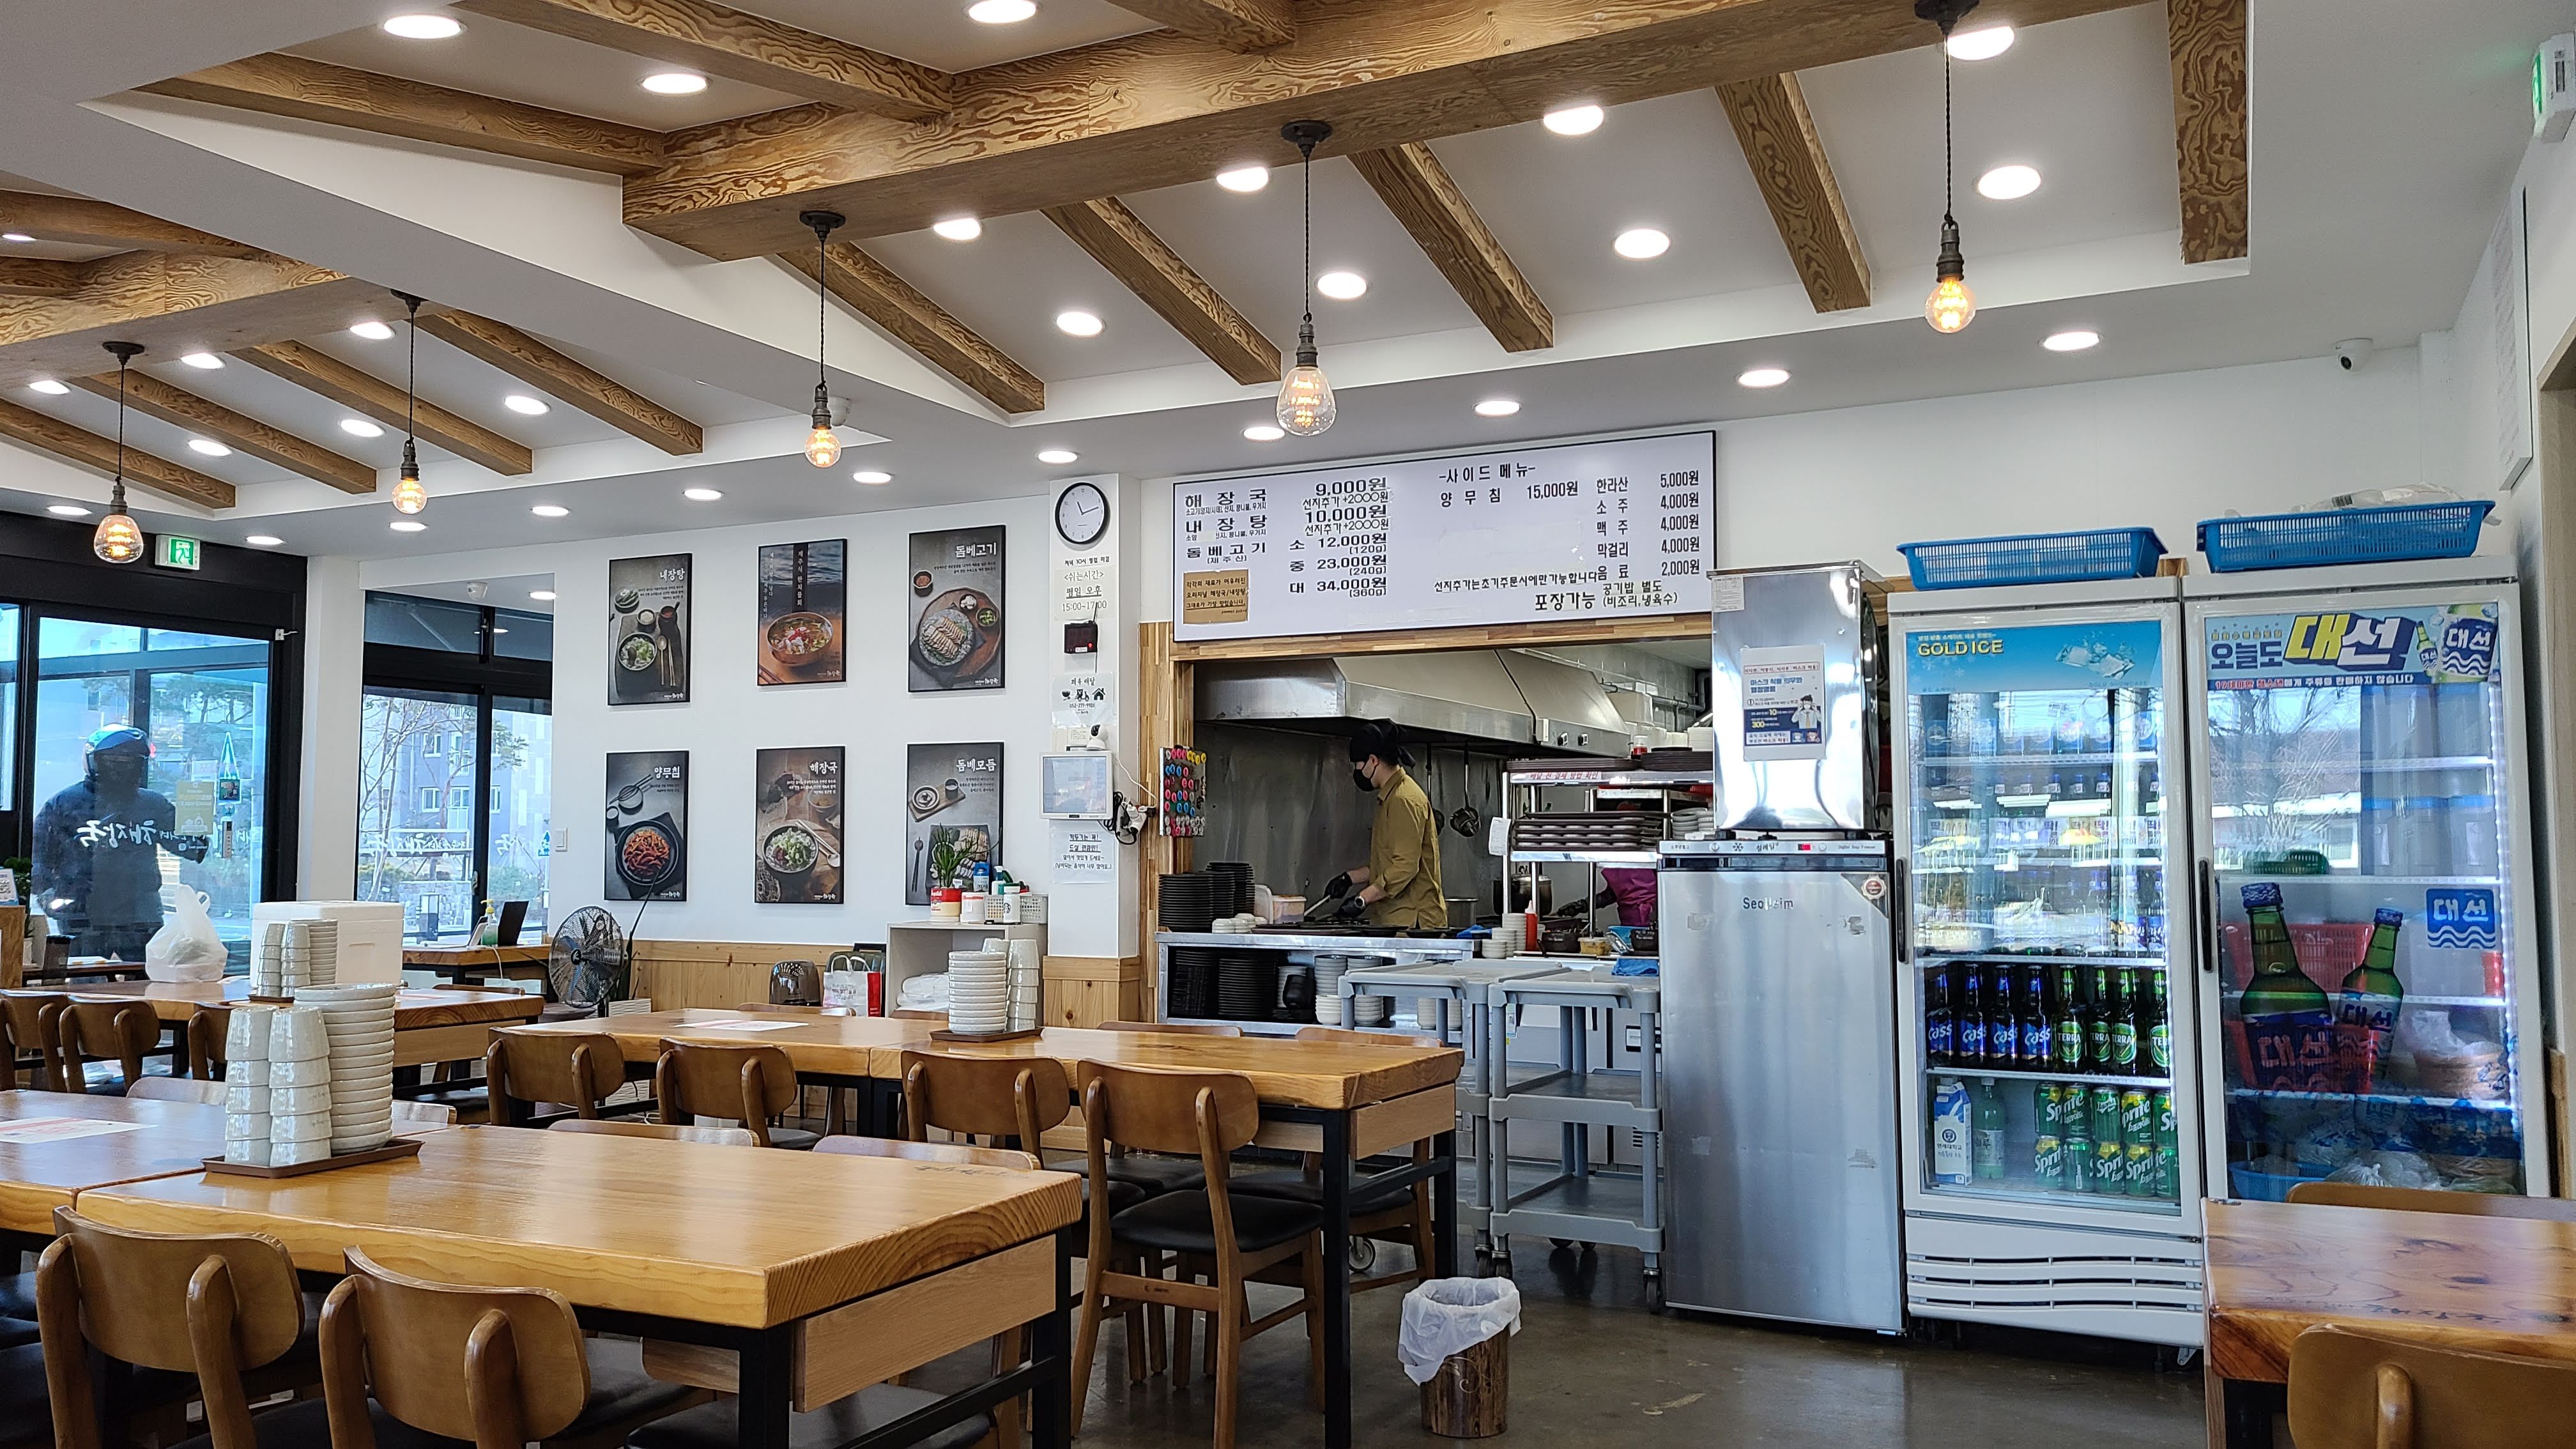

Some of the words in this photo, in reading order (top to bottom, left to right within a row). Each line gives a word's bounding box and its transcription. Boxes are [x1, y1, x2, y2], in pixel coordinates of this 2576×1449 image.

[1315, 477, 1386, 496] 9,000원
[1526, 480, 1578, 500] 15,000원
[1597, 477, 1629, 494] 한라산
[1660, 470, 1699, 487] 5,000원
[1302, 496, 1340, 510] 선지추가
[1343, 490, 1388, 504] +2000원
[1597, 498, 1629, 515] 소주
[1660, 492, 1699, 510] 4,000원
[1305, 505, 1386, 524] 10,000원
[1305, 524, 1342, 537] 선지추가
[1344, 518, 1389, 530] +2000원
[1597, 519, 1629, 537] 맥주
[1660, 514, 1699, 532] 4,000원
[955, 542, 997, 558] 돔베고기
[1289, 540, 1305, 551] 소
[1318, 533, 1386, 548] 12,000원
[1349, 544, 1386, 554] (120g)
[1597, 542, 1629, 558] 막걸리
[1661, 536, 1700, 554] 4,000원
[1289, 560, 1305, 572] 중
[1317, 555, 1386, 569] 23,000원
[1349, 567, 1386, 576] (240g)
[1598, 564, 1629, 581] 음료
[1661, 558, 1700, 576] 2,000원
[659, 567, 686, 581] 내장탕
[1064, 569, 1104, 581] <쉬는시간>
[1066, 586, 1082, 597] 평일
[1086, 585, 1102, 595] 오후
[1289, 582, 1304, 594] 대
[1317, 577, 1386, 592] 34,000원
[1349, 588, 1386, 597] (360g)
[1603, 582, 1635, 595] 공기밥
[1641, 579, 1662, 594] 별도
[1062, 600, 1107, 611] 15:00~1700
[1535, 591, 1596, 611] 포장가능
[2211, 640, 2283, 670] 오늘도
[2284, 612, 2402, 666] 대선
[2446, 627, 2491, 652] 대선
[1918, 641, 1968, 657] GOLD
[1972, 640, 2004, 655] ICE
[2376, 673, 2414, 685] 않습니다
[654, 765, 680, 779] 양무침
[809, 761, 838, 775] 해장국
[2433, 898, 2489, 922] 대선
[2057, 1032, 2081, 1042] TERRA
[2152, 1036, 2168, 1046] TER
[2257, 1030, 2332, 1068] 대선
[2122, 1100, 2150, 1129] prite
